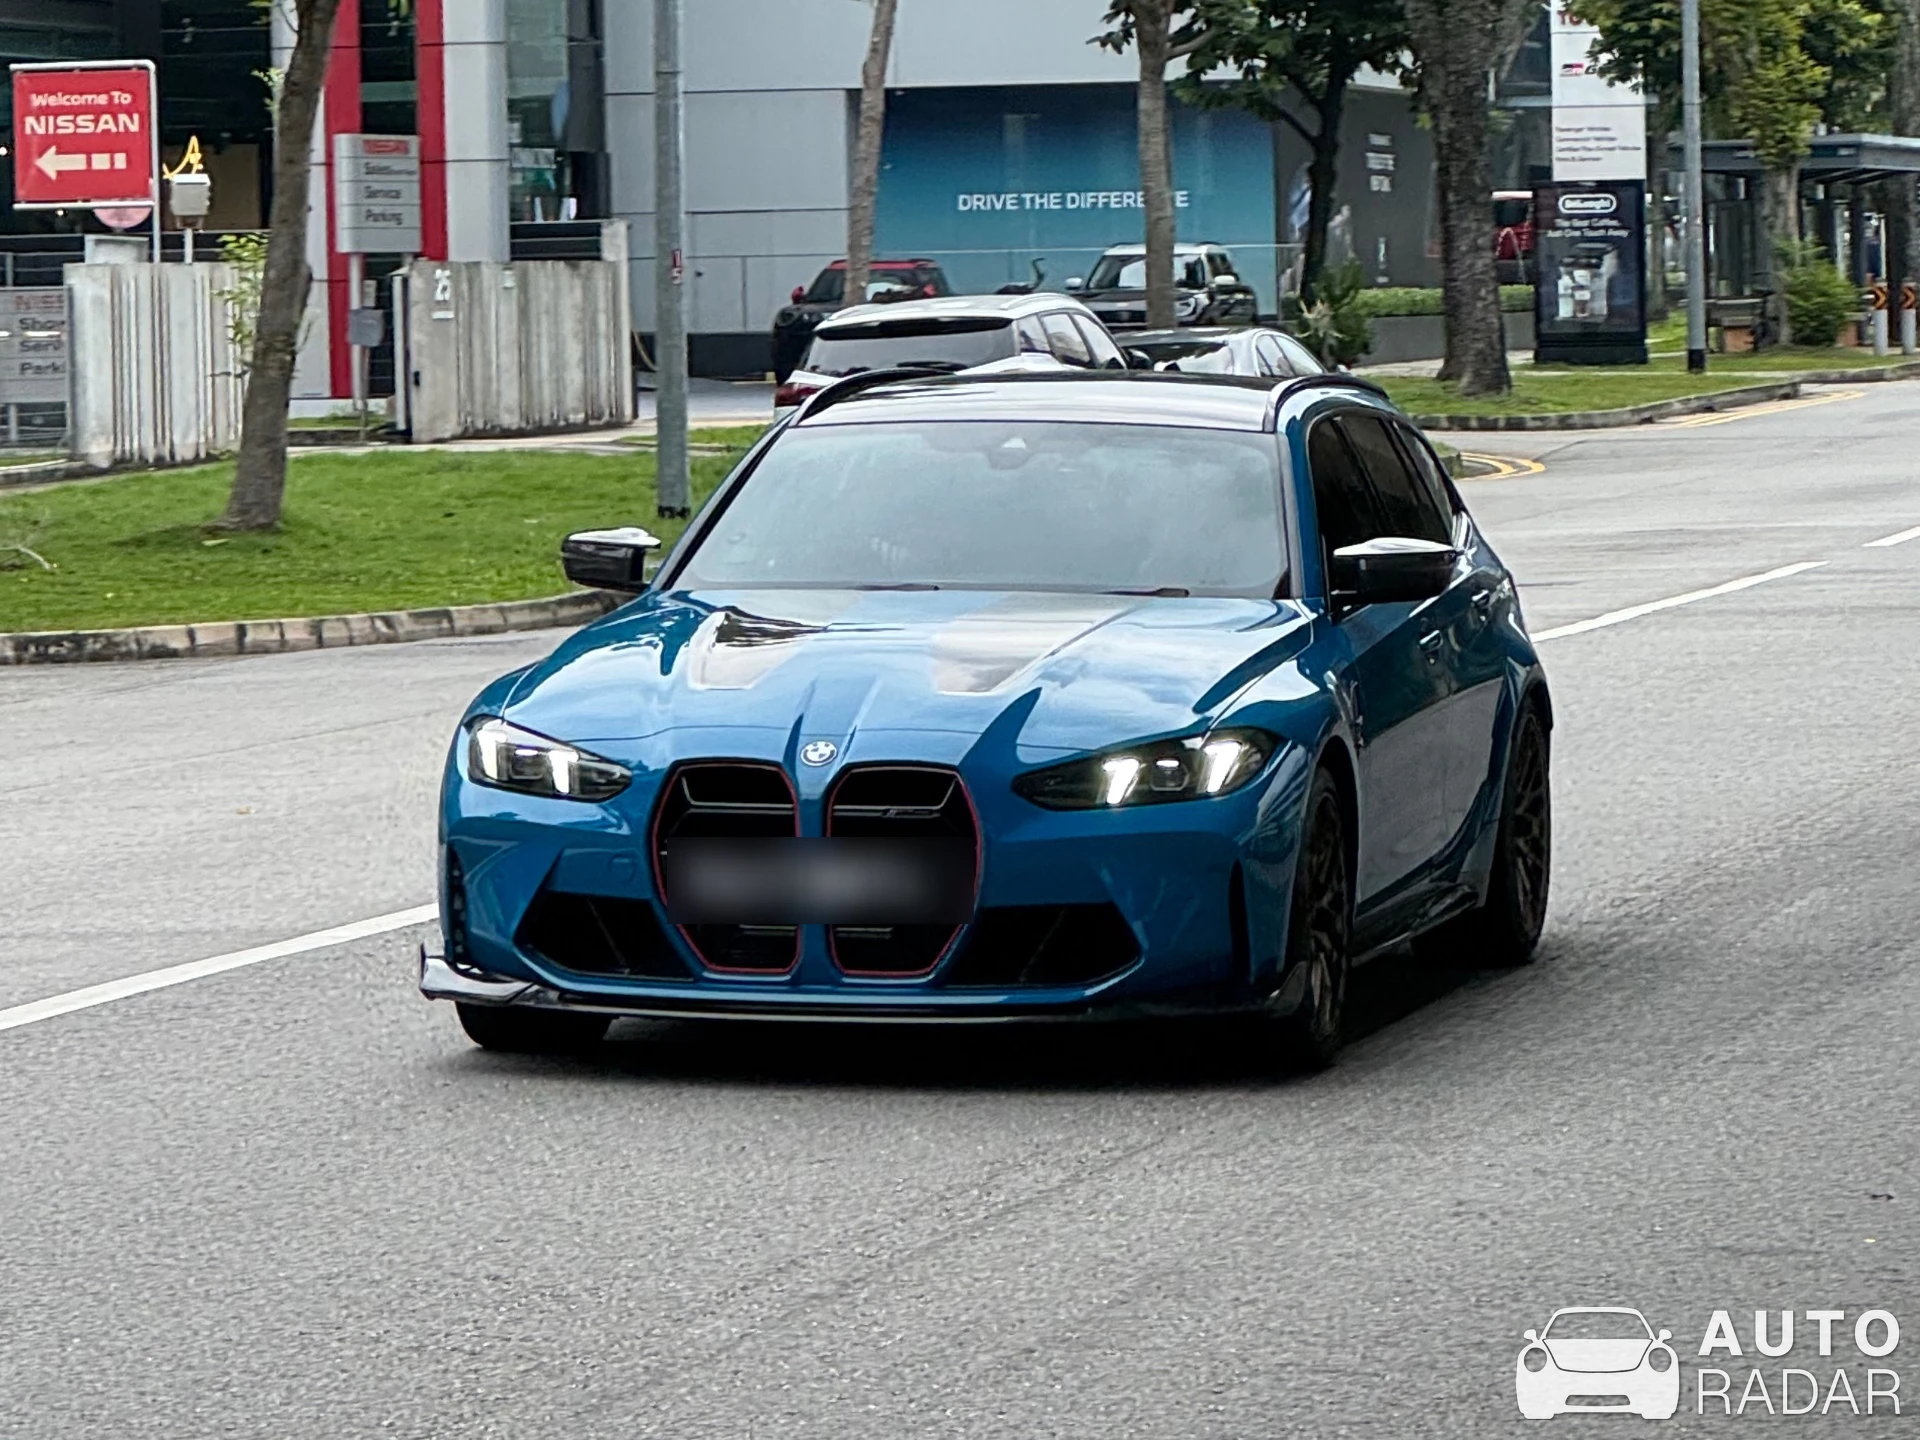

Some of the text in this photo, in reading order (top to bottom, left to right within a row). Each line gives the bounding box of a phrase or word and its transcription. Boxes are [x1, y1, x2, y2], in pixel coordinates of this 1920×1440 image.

[30, 91, 132, 107] Welcome To
[24, 113, 140, 135] NISSAN
[957, 190, 1190, 211] DRIVE THE DIFFEREE
